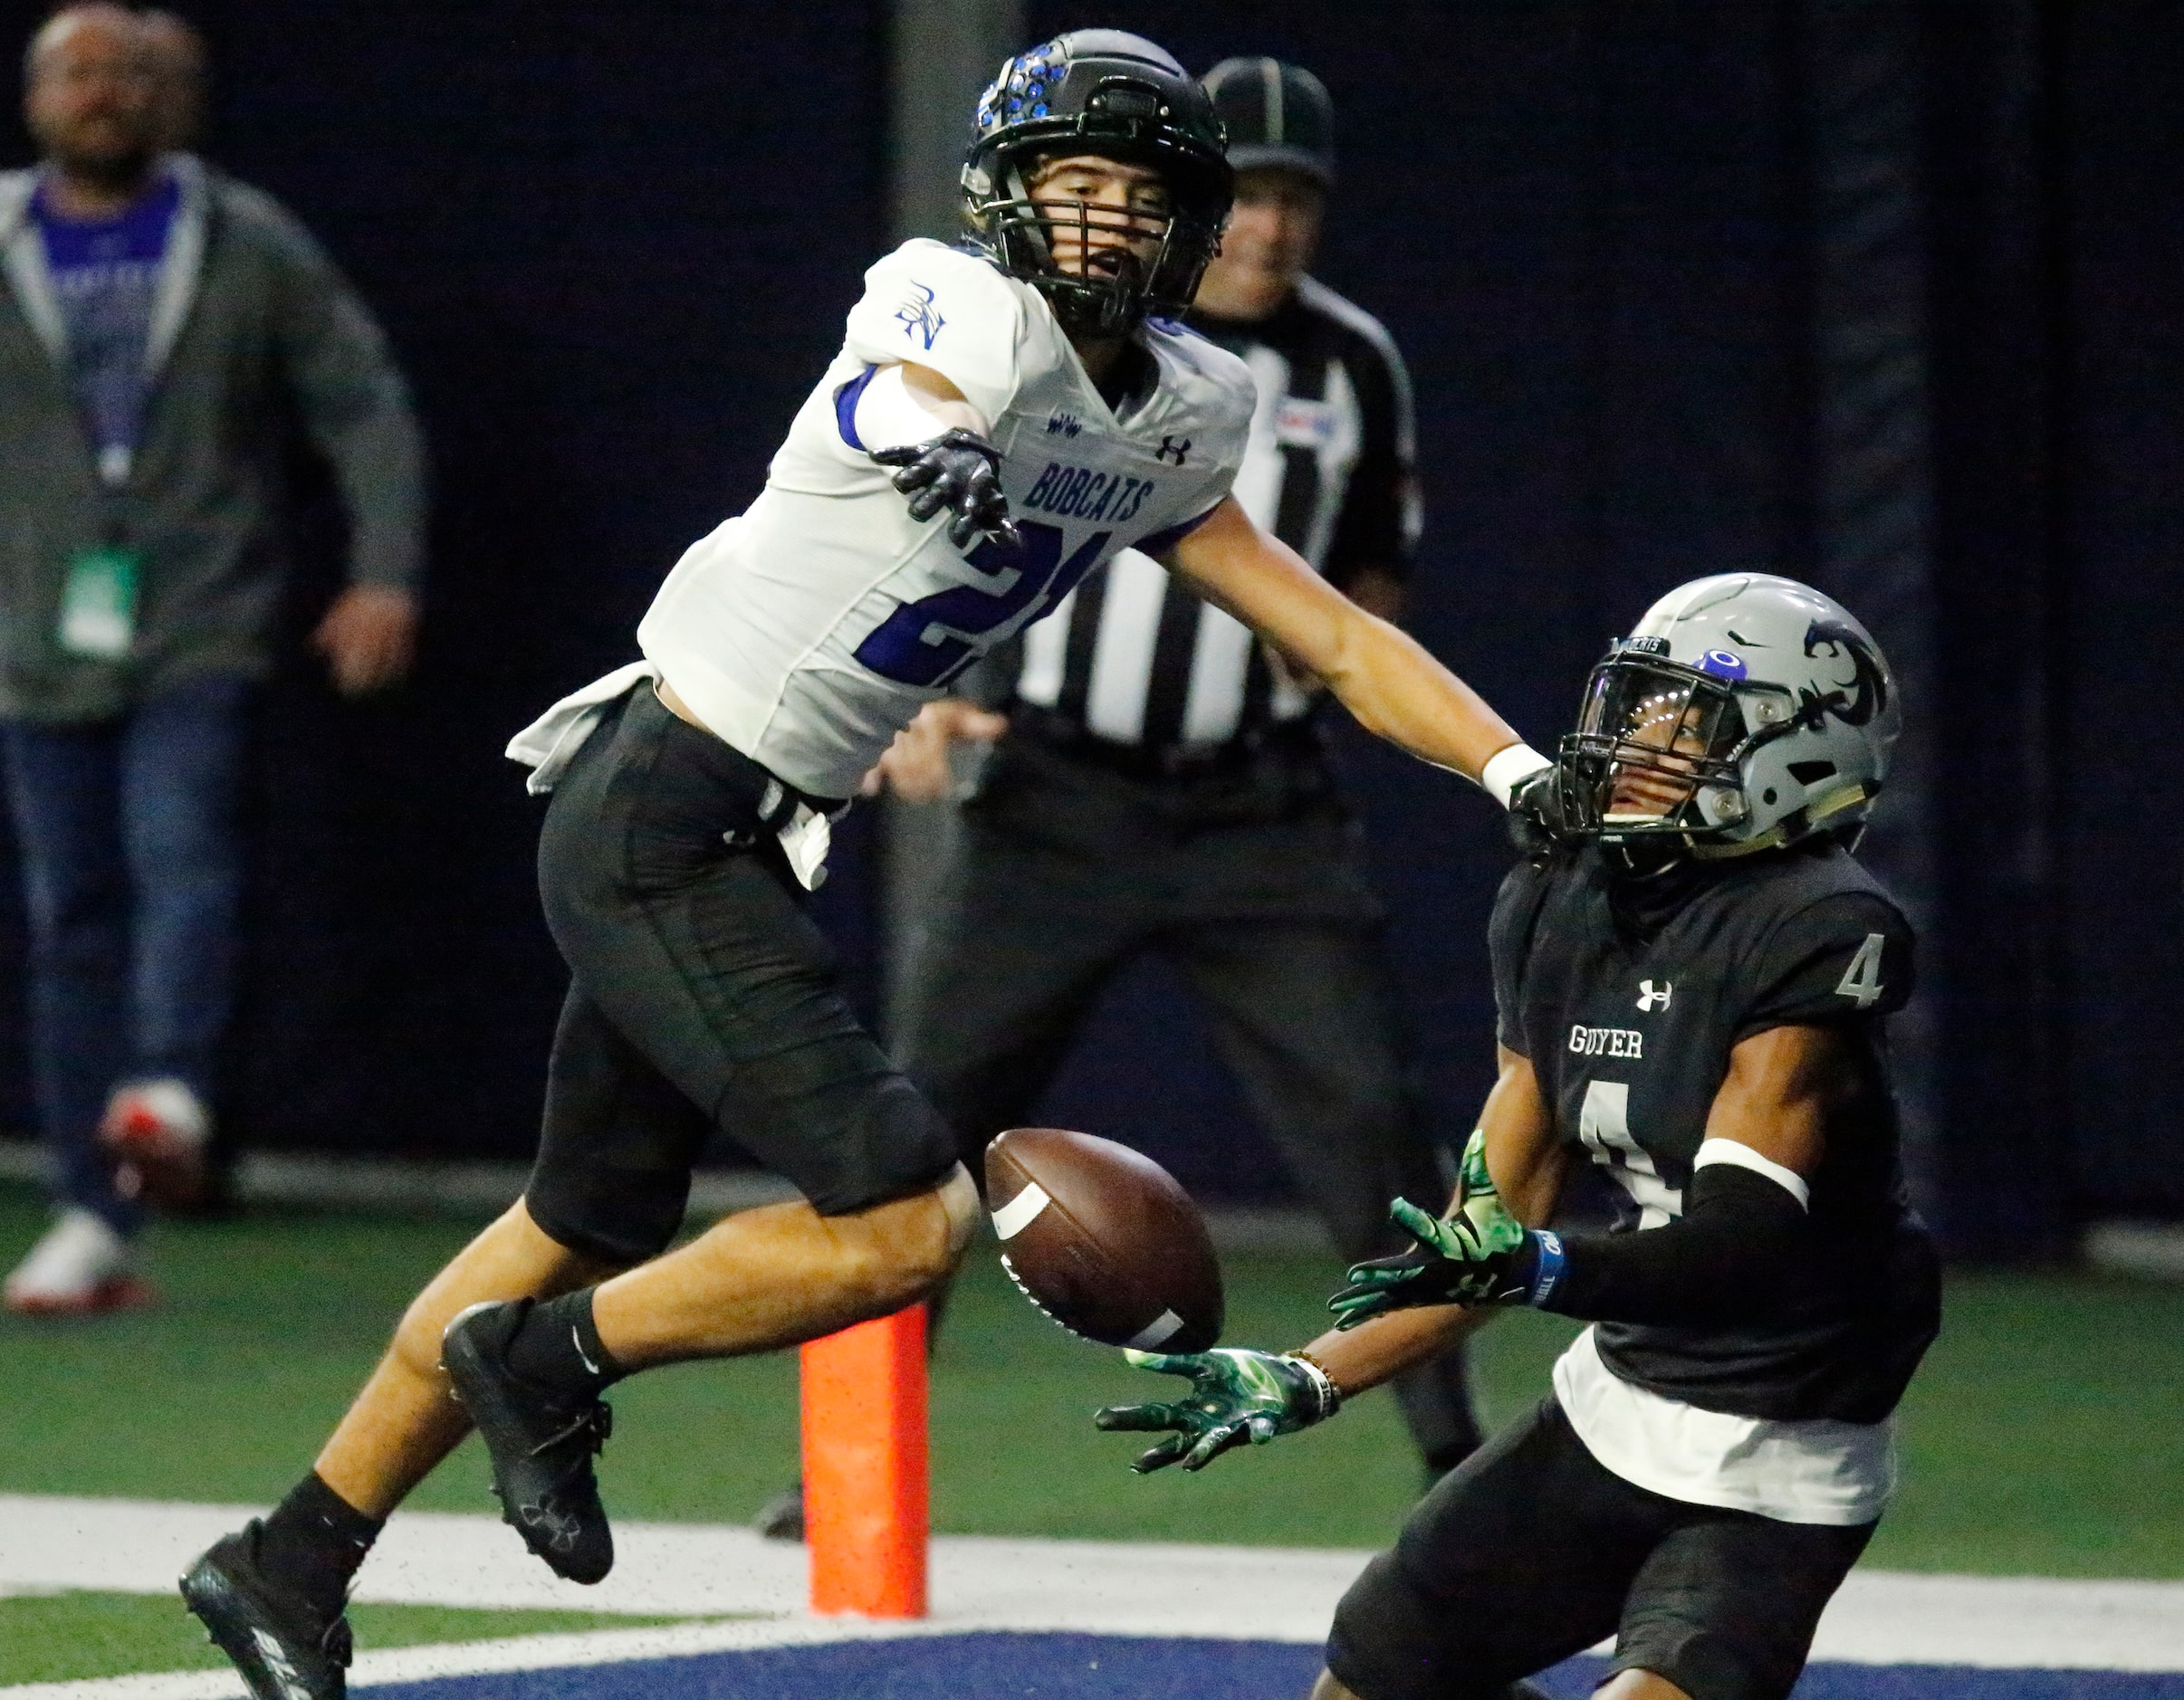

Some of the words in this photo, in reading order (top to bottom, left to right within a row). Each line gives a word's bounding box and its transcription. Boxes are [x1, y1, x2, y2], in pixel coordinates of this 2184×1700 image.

[1021, 462, 1155, 523] BOBCATS
[1835, 933, 1885, 1008] 4
[1569, 1024, 1643, 1059] GUYER
